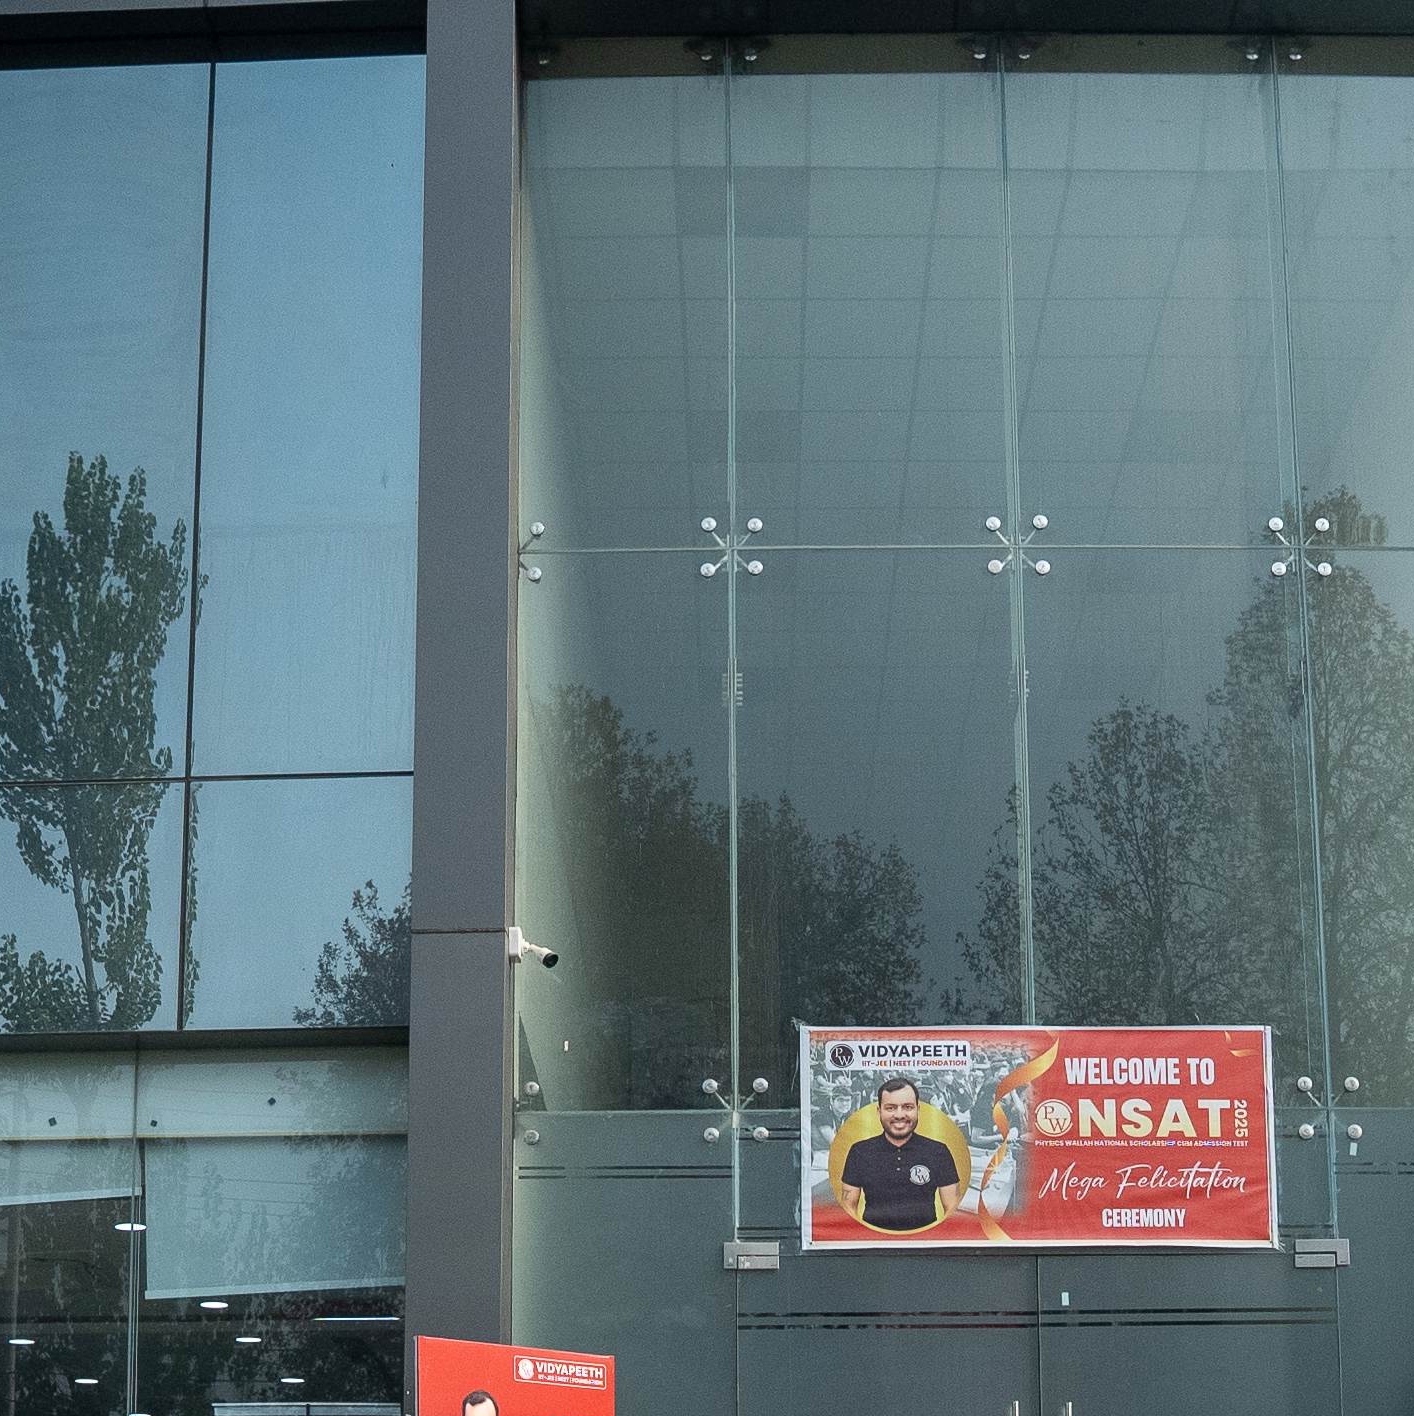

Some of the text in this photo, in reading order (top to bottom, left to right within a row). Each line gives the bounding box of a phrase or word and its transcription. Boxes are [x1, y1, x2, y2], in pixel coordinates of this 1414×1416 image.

[858, 1045, 967, 1058] VIDYAPEETH
[1064, 1057, 1215, 1086] WELCOME TO
[1078, 1098, 1231, 1138] NSAT
[1234, 1099, 1249, 1138] 2025
[1039, 1160, 1247, 1200] Mega Felicitation
[1101, 1207, 1186, 1228] CEREMONY
[535, 1361, 604, 1379] VIDYAPEETH
